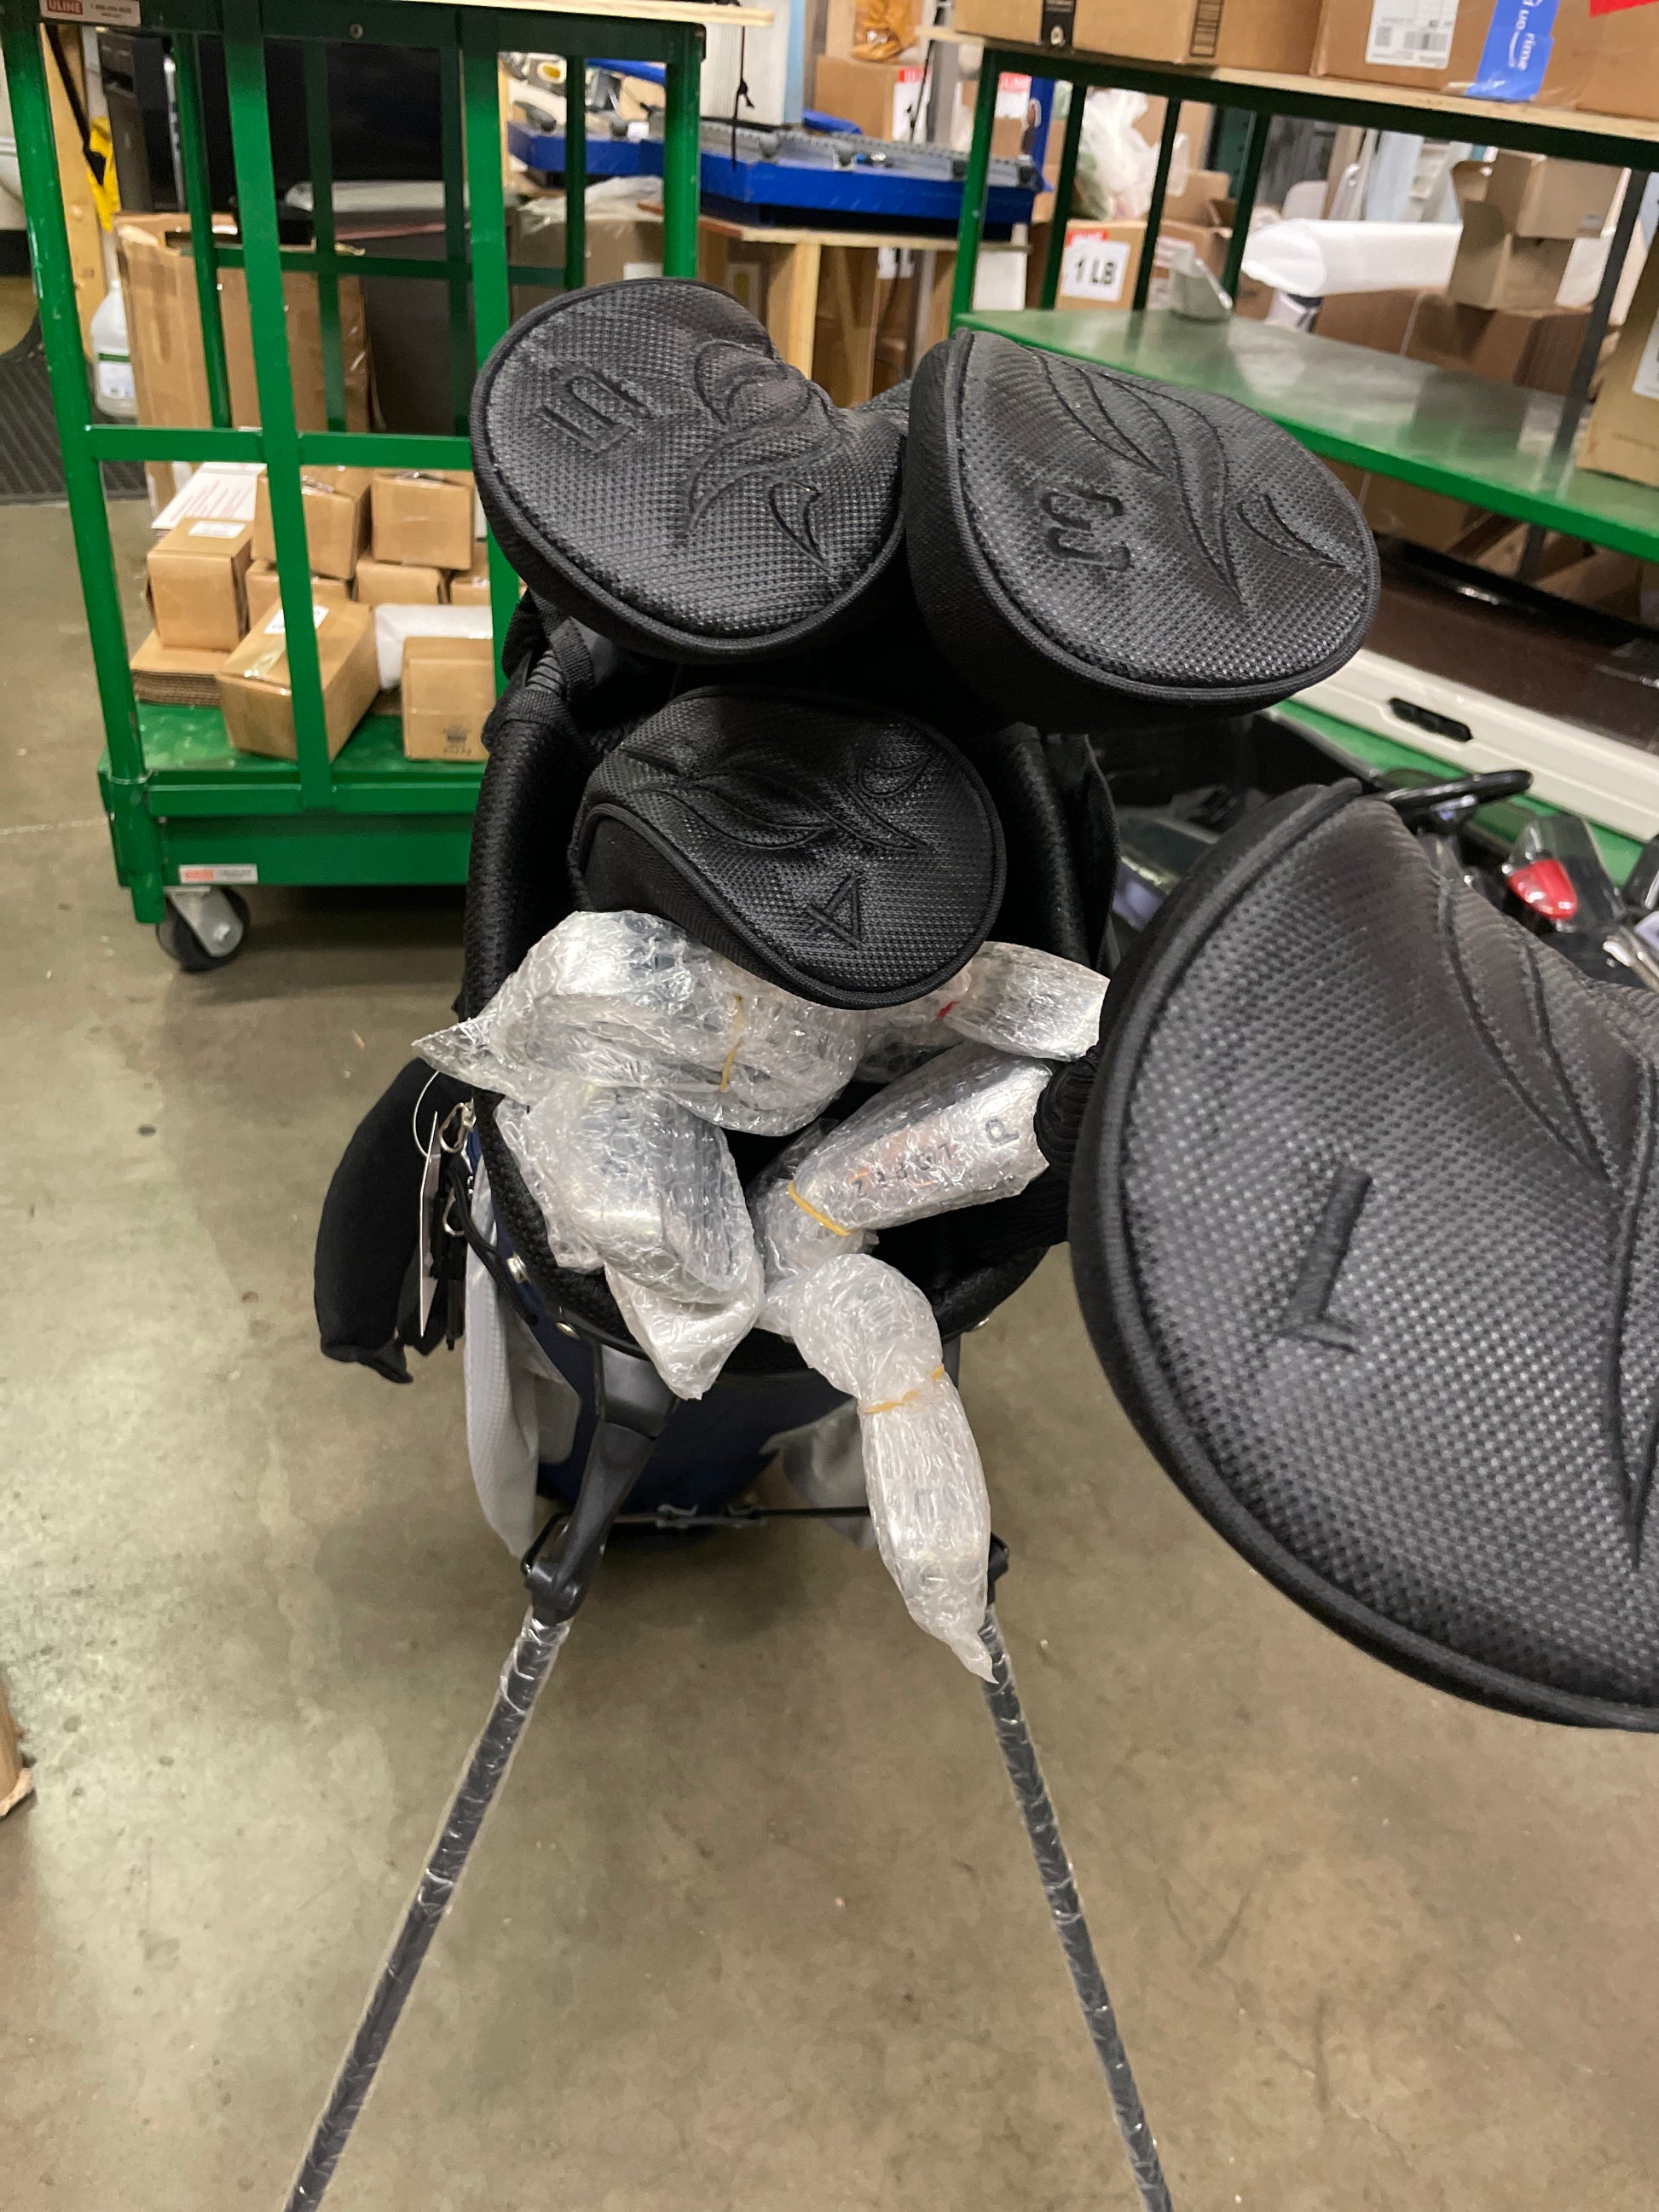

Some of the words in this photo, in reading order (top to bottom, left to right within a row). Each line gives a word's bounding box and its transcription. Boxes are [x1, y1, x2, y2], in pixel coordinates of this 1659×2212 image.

[48, 0, 82, 14] ULINE
[1075, 258, 1085, 283] 1
[1090, 259, 1117, 285] LB
[1039, 485, 1134, 572] 3
[806, 871, 864, 950] 4
[984, 1118, 1020, 1149] P
[1275, 1166, 1372, 1354] 1
